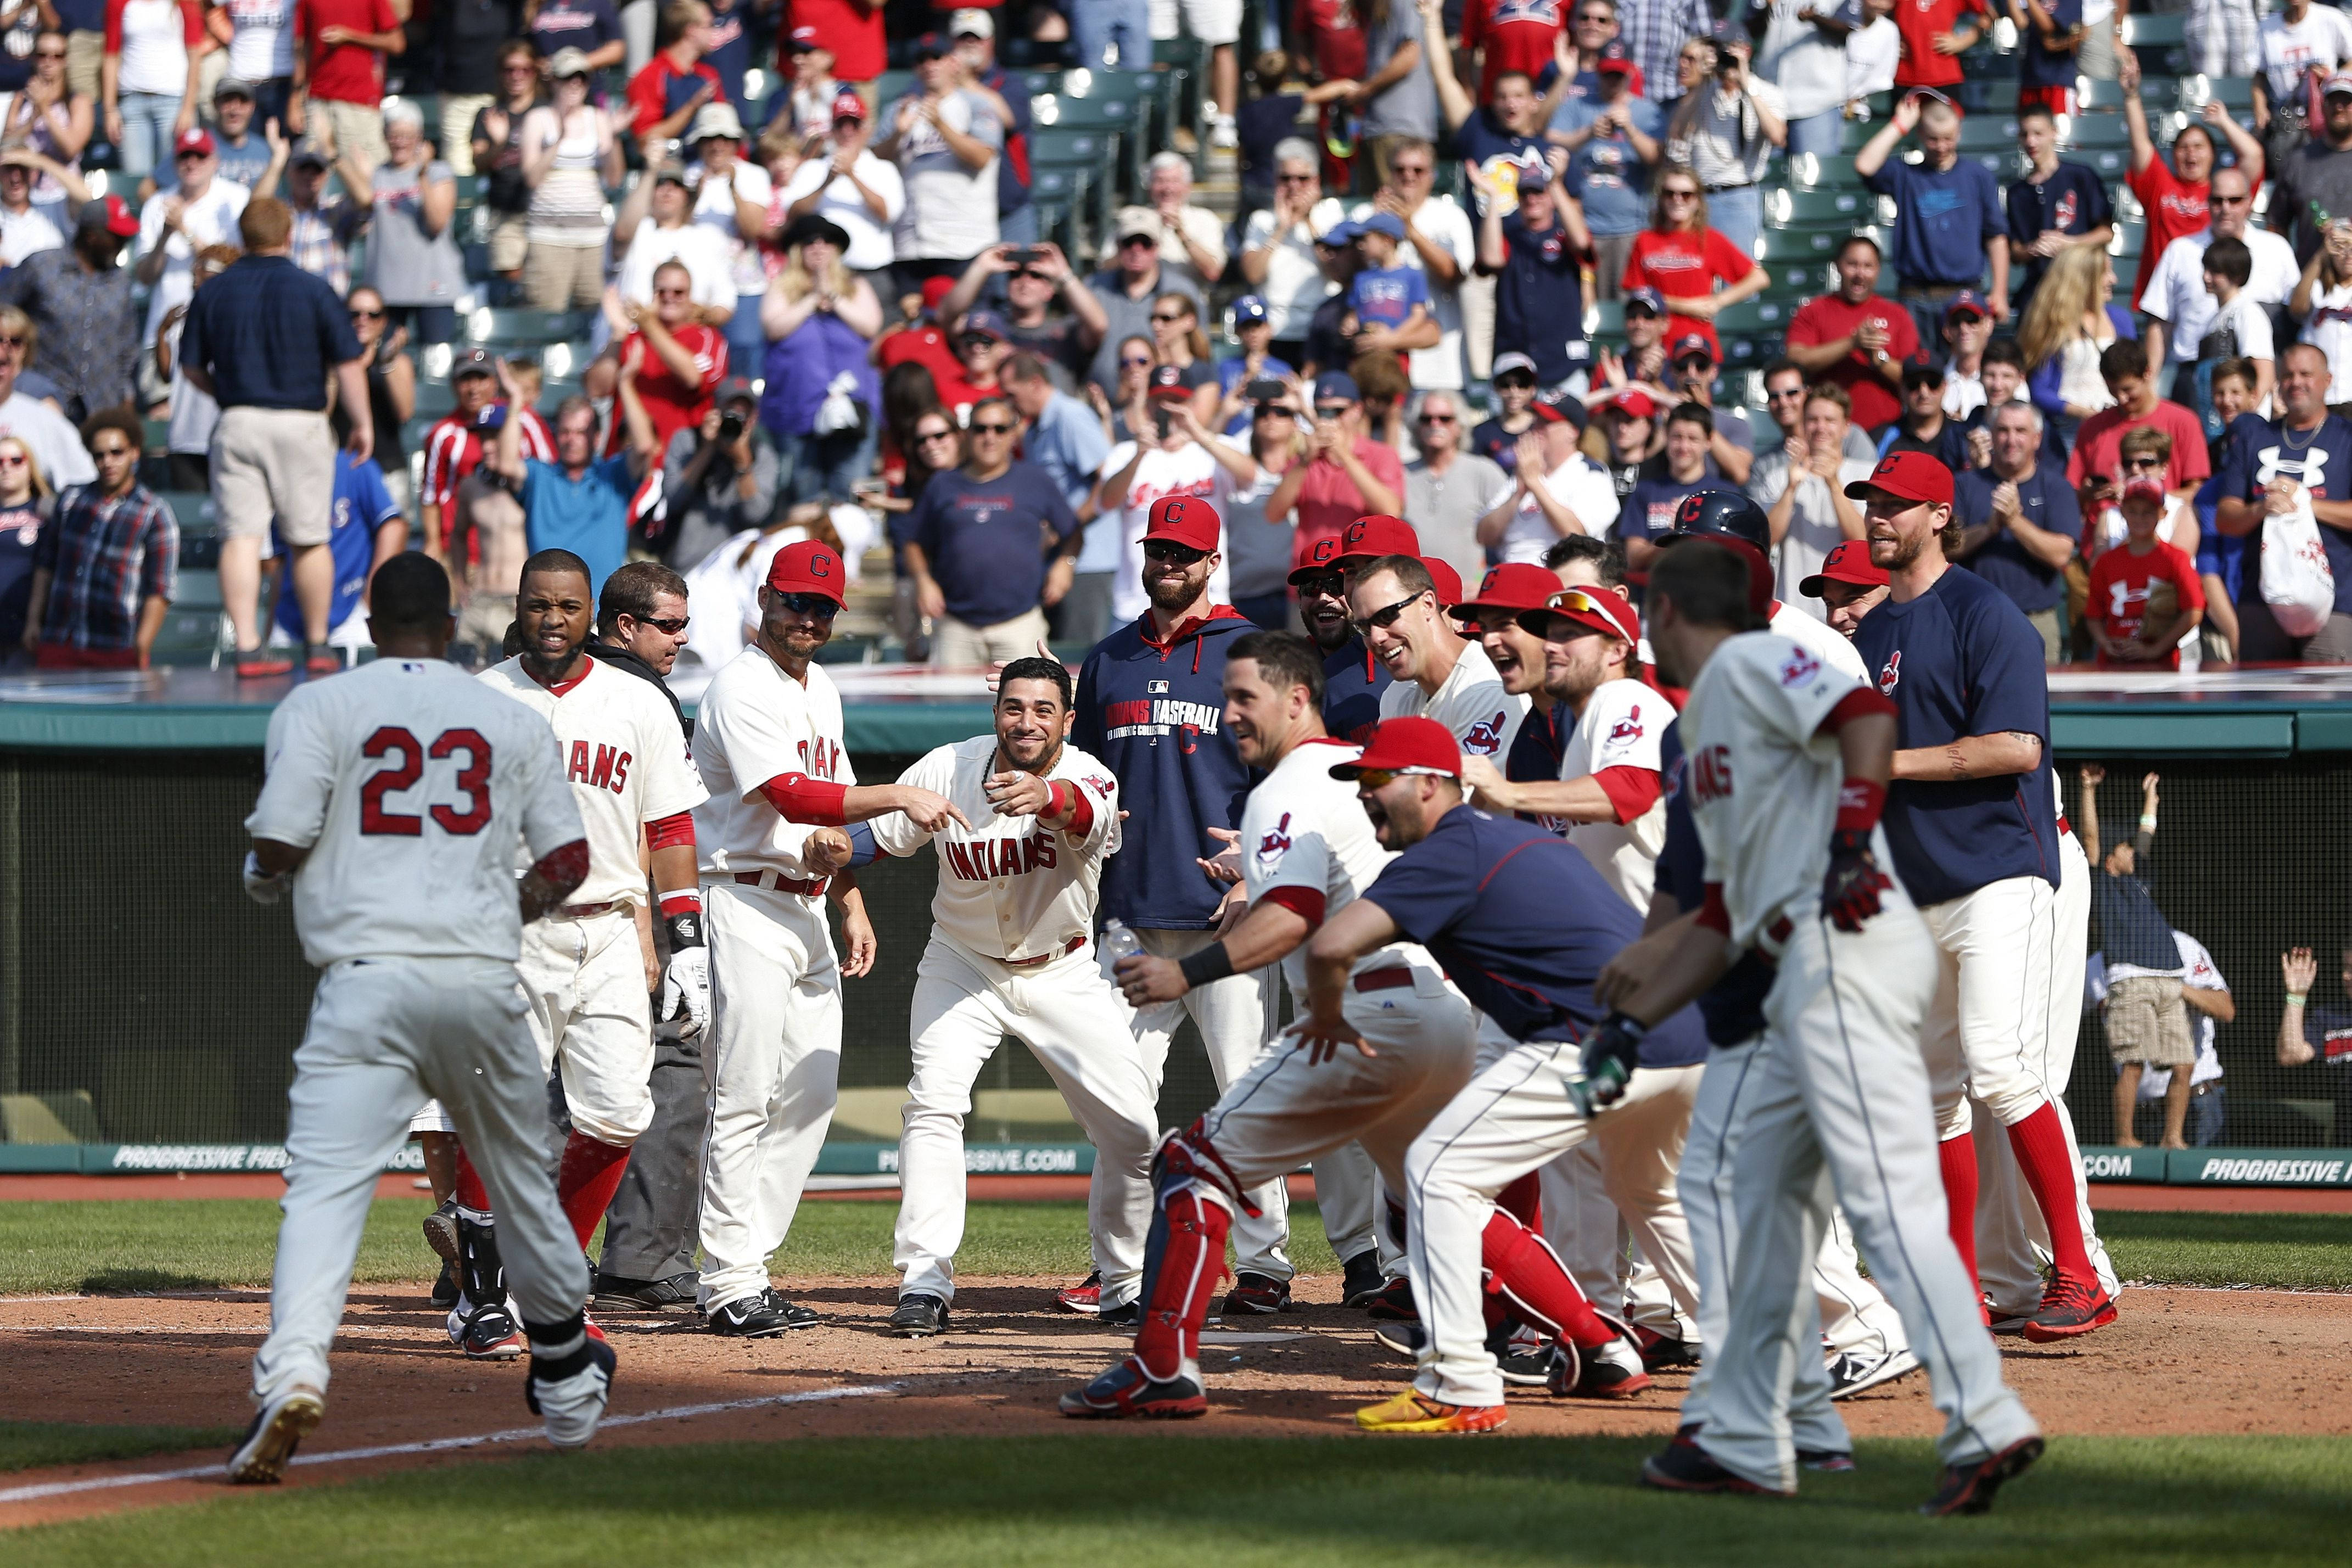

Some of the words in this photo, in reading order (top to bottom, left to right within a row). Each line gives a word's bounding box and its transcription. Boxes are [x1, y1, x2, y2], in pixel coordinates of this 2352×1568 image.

[1878, 455, 1902, 474] C
[1165, 502, 1186, 524] C
[1683, 497, 1704, 522] C
[1349, 521, 1367, 542] C
[1313, 540, 1334, 562] C
[1828, 545, 1848, 565] C
[810, 554, 830, 578] C
[1180, 722, 1200, 755] C
[557, 740, 632, 795] ANS
[361, 726, 493, 836] 23
[945, 831, 1057, 882] INDIANS
[113, 1145, 247, 1169] PROGRESSIVE
[2200, 1157, 2344, 1183] PROGRESSIVE
